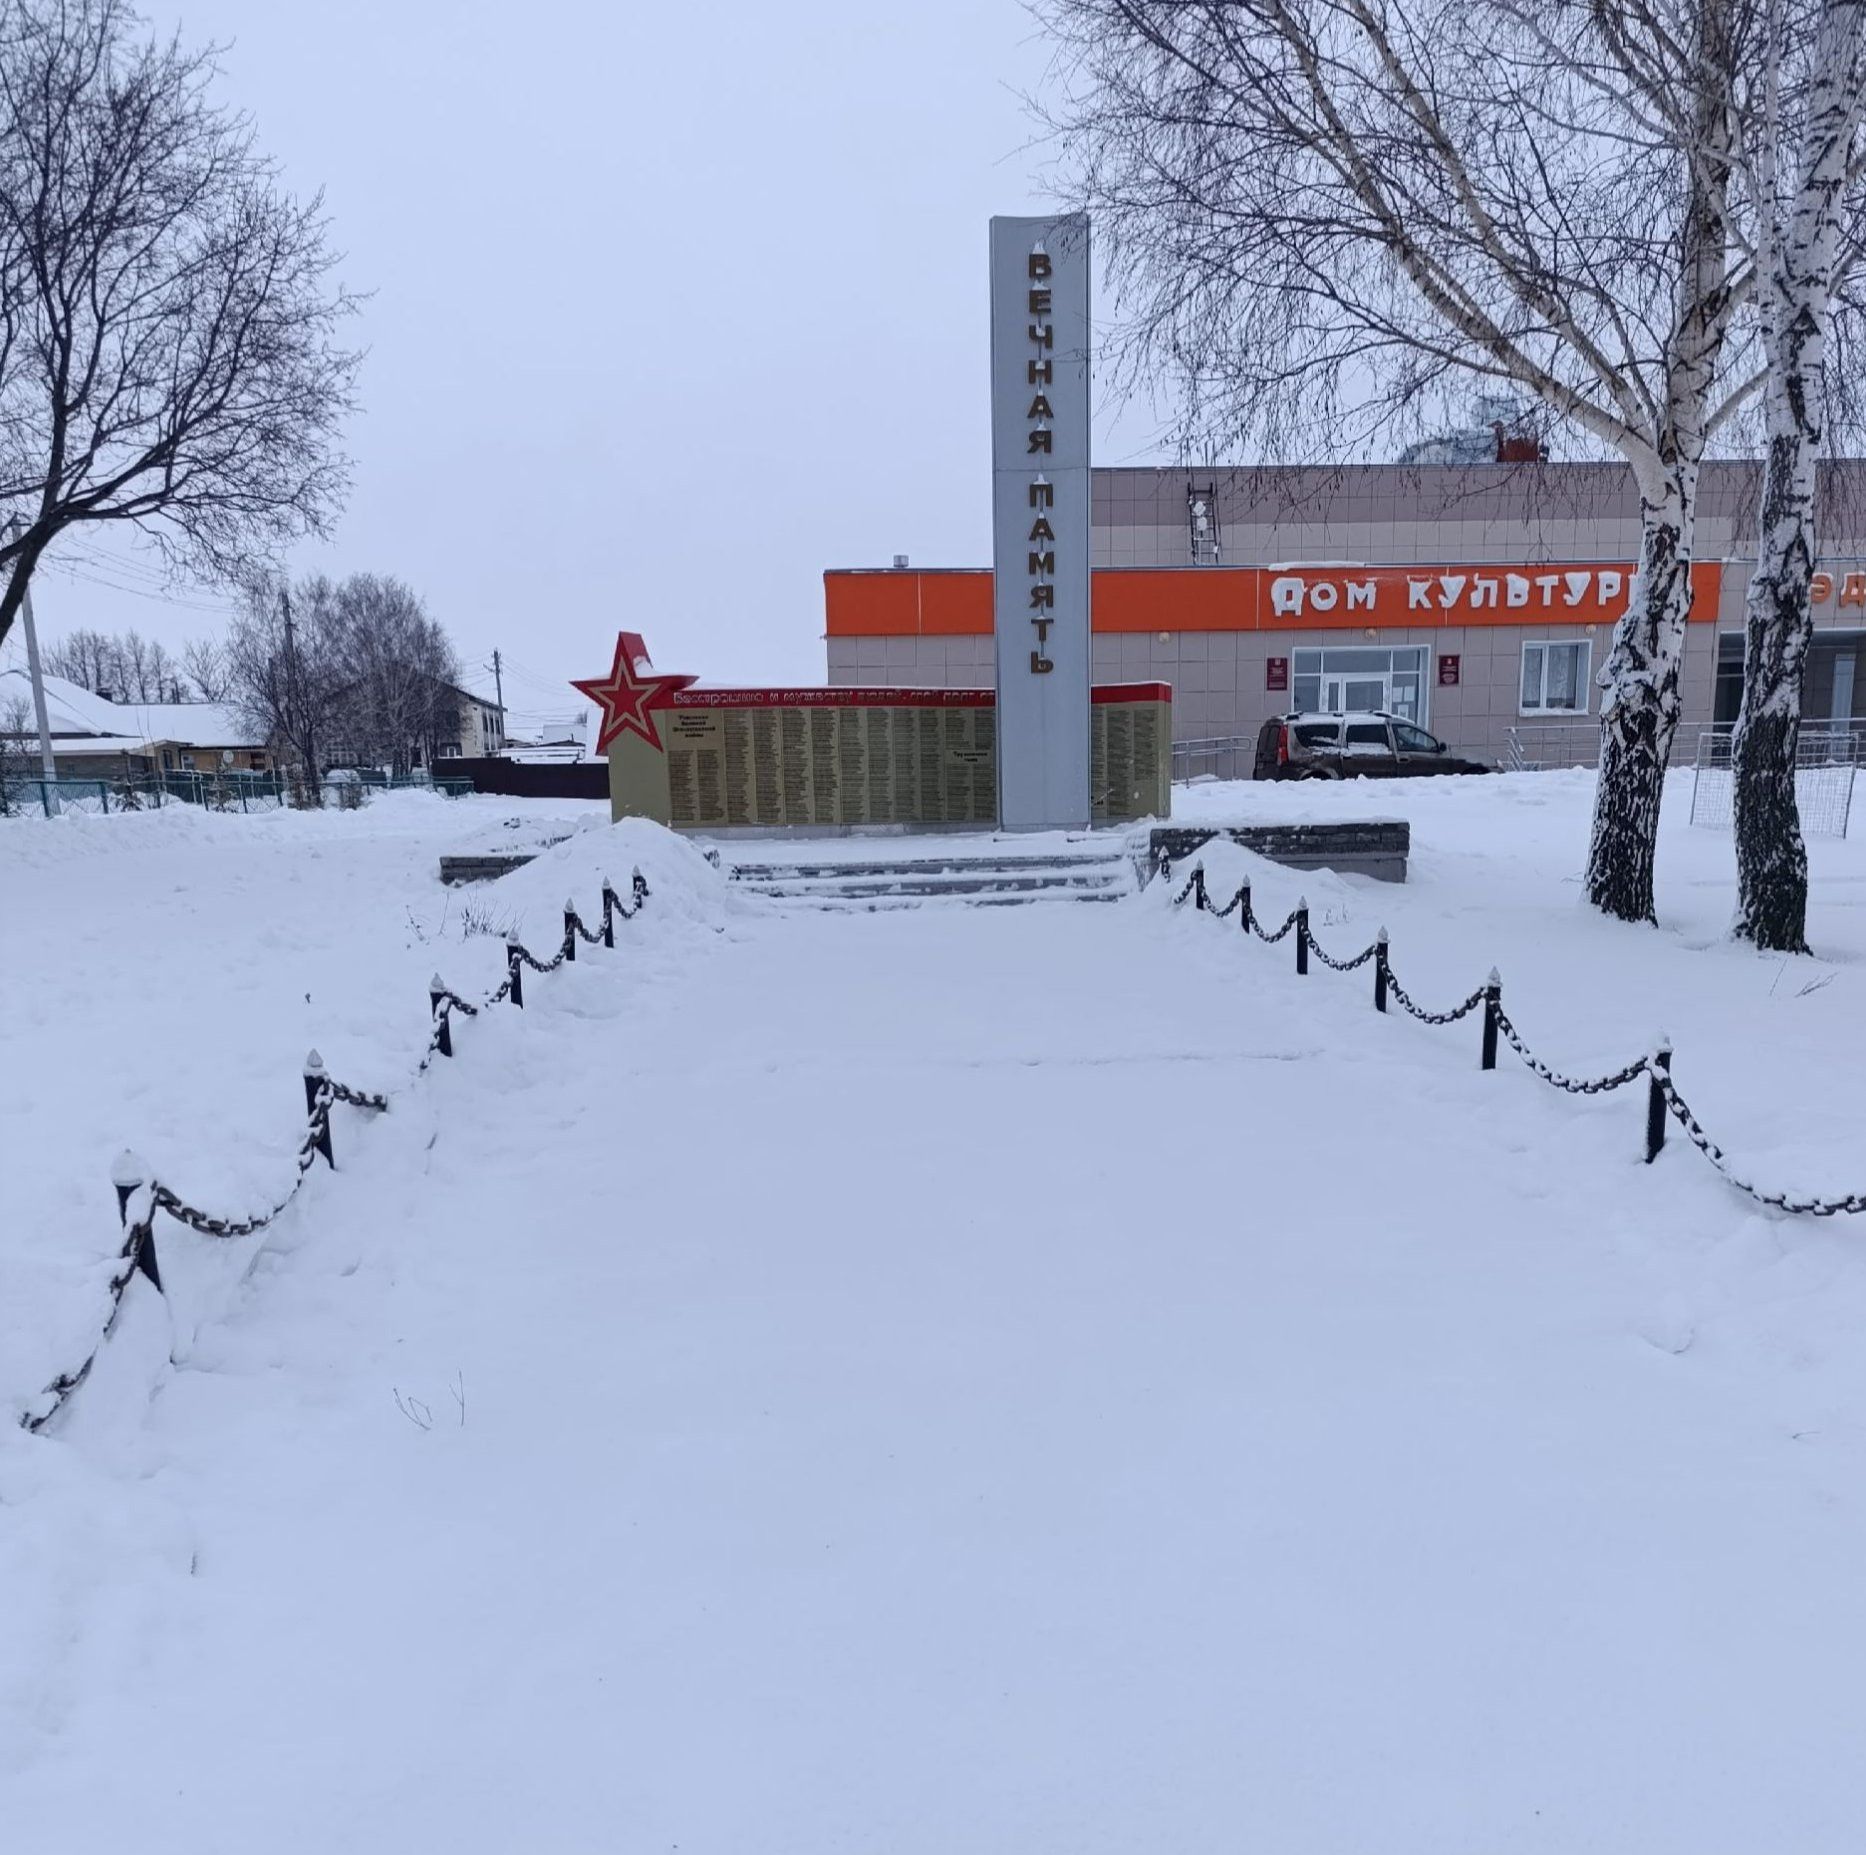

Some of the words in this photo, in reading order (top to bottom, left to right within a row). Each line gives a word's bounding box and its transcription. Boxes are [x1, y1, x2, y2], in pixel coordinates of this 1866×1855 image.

[1027, 253, 1054, 454] ВЕЧНАЯ
[1028, 483, 1055, 674] ПАМЯТЬ
[1271, 577, 1377, 616] ДОМ
[1406, 571, 1639, 610] КУЛЬТУР
